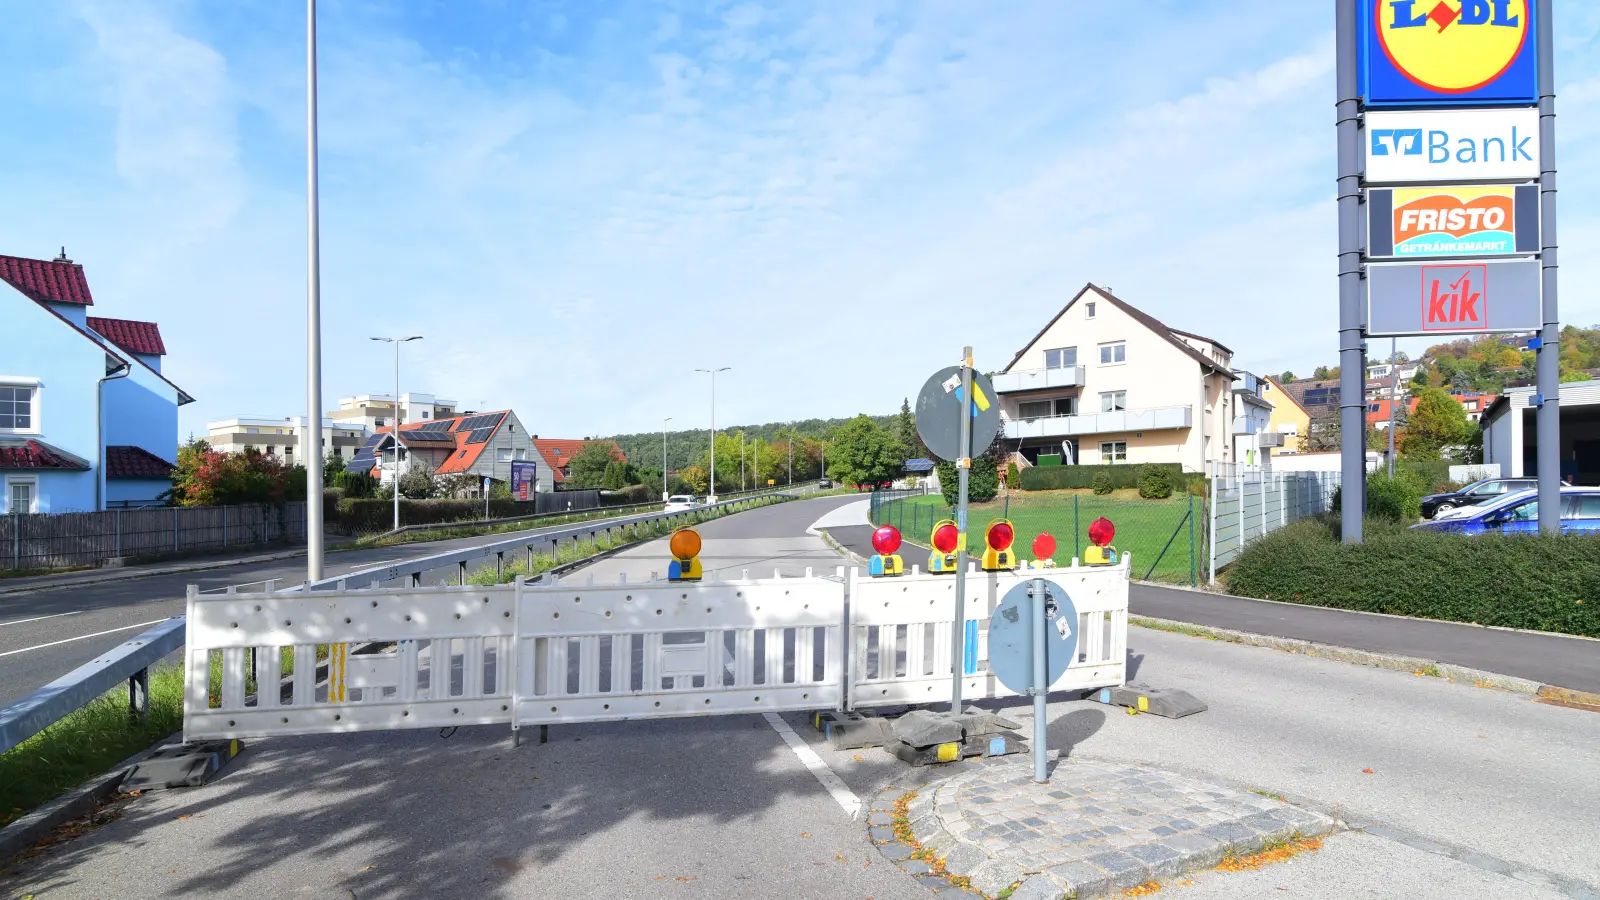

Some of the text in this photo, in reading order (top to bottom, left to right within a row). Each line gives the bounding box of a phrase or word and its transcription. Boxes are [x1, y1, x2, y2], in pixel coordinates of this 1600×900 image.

[1428, 125, 1534, 164] Bank
[1399, 206, 1505, 232] FRISTO
[1399, 240, 1508, 254] GETRÄNKEMARKT
[1427, 269, 1481, 324] kik
